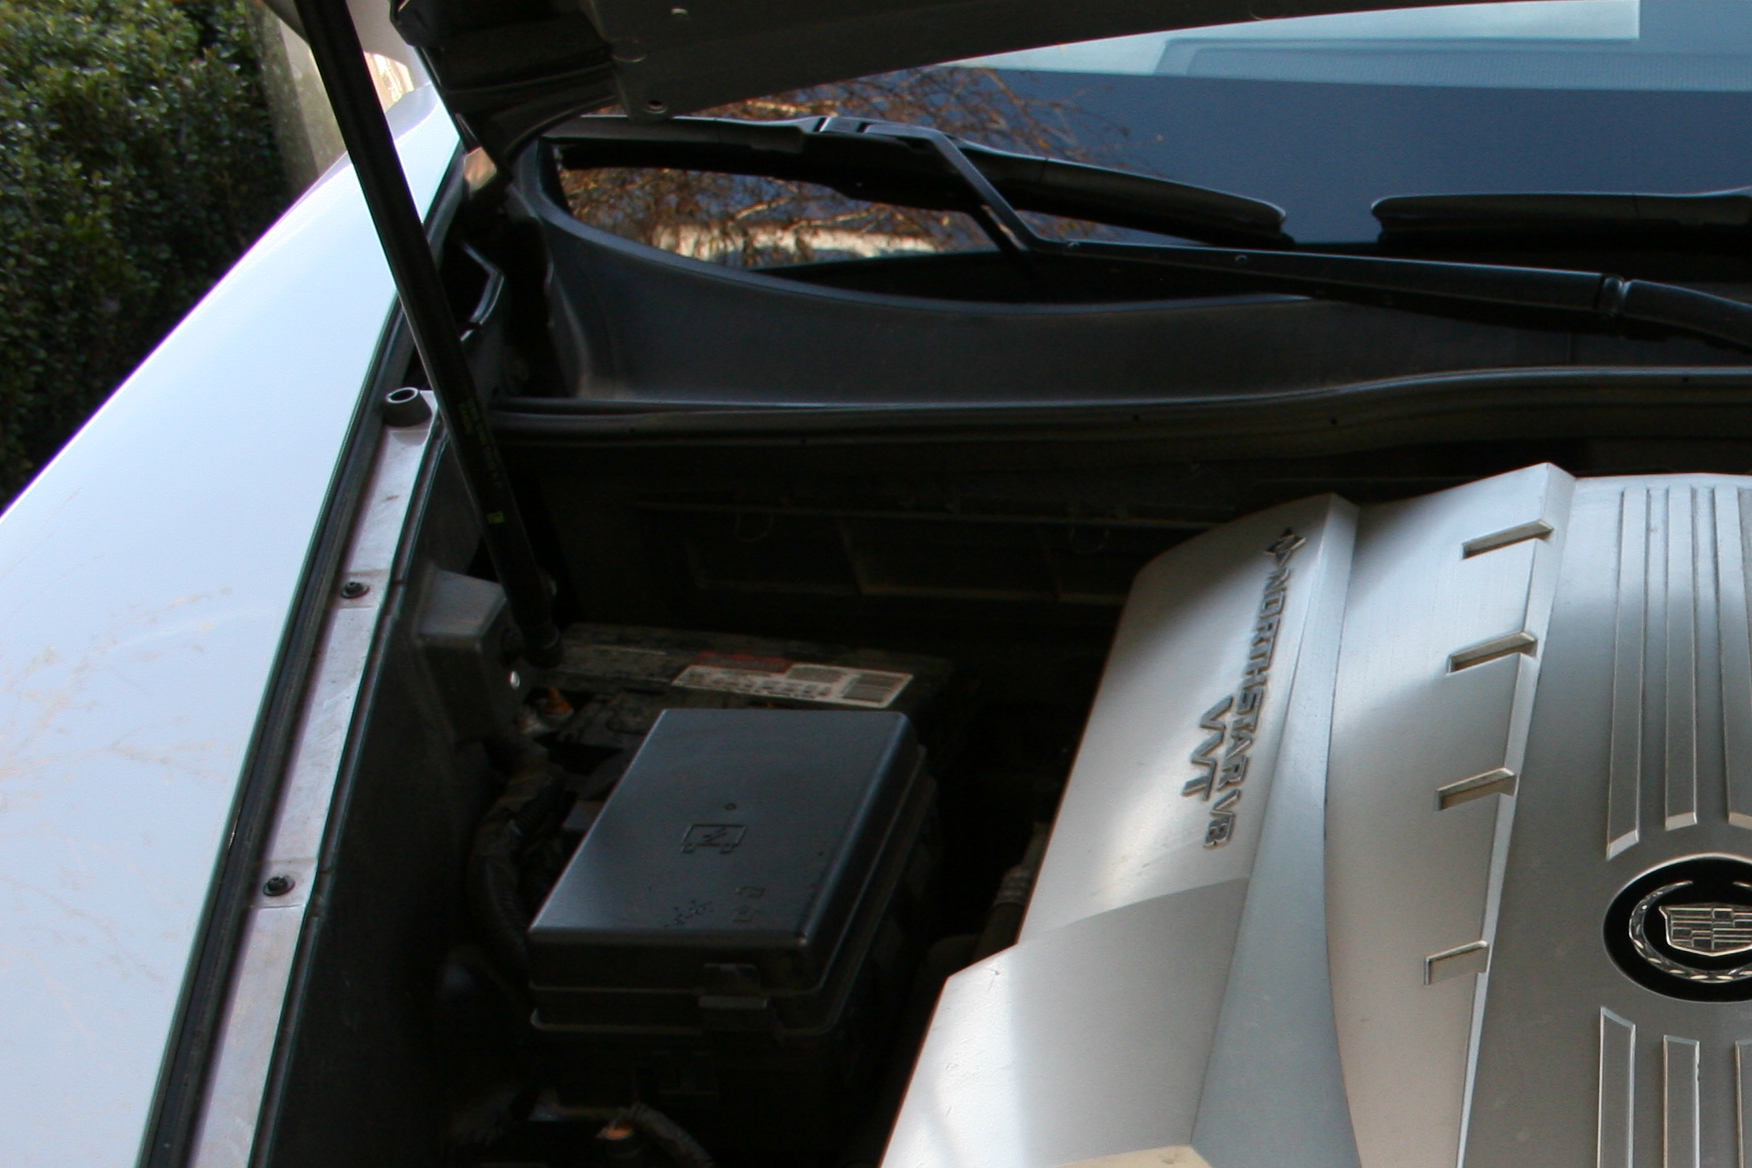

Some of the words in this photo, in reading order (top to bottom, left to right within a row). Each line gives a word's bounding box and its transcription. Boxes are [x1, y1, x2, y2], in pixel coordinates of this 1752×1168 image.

[1216, 566, 1290, 793] NORTHSTAR
[1180, 694, 1234, 803] VVT
[1203, 788, 1241, 849] V8
